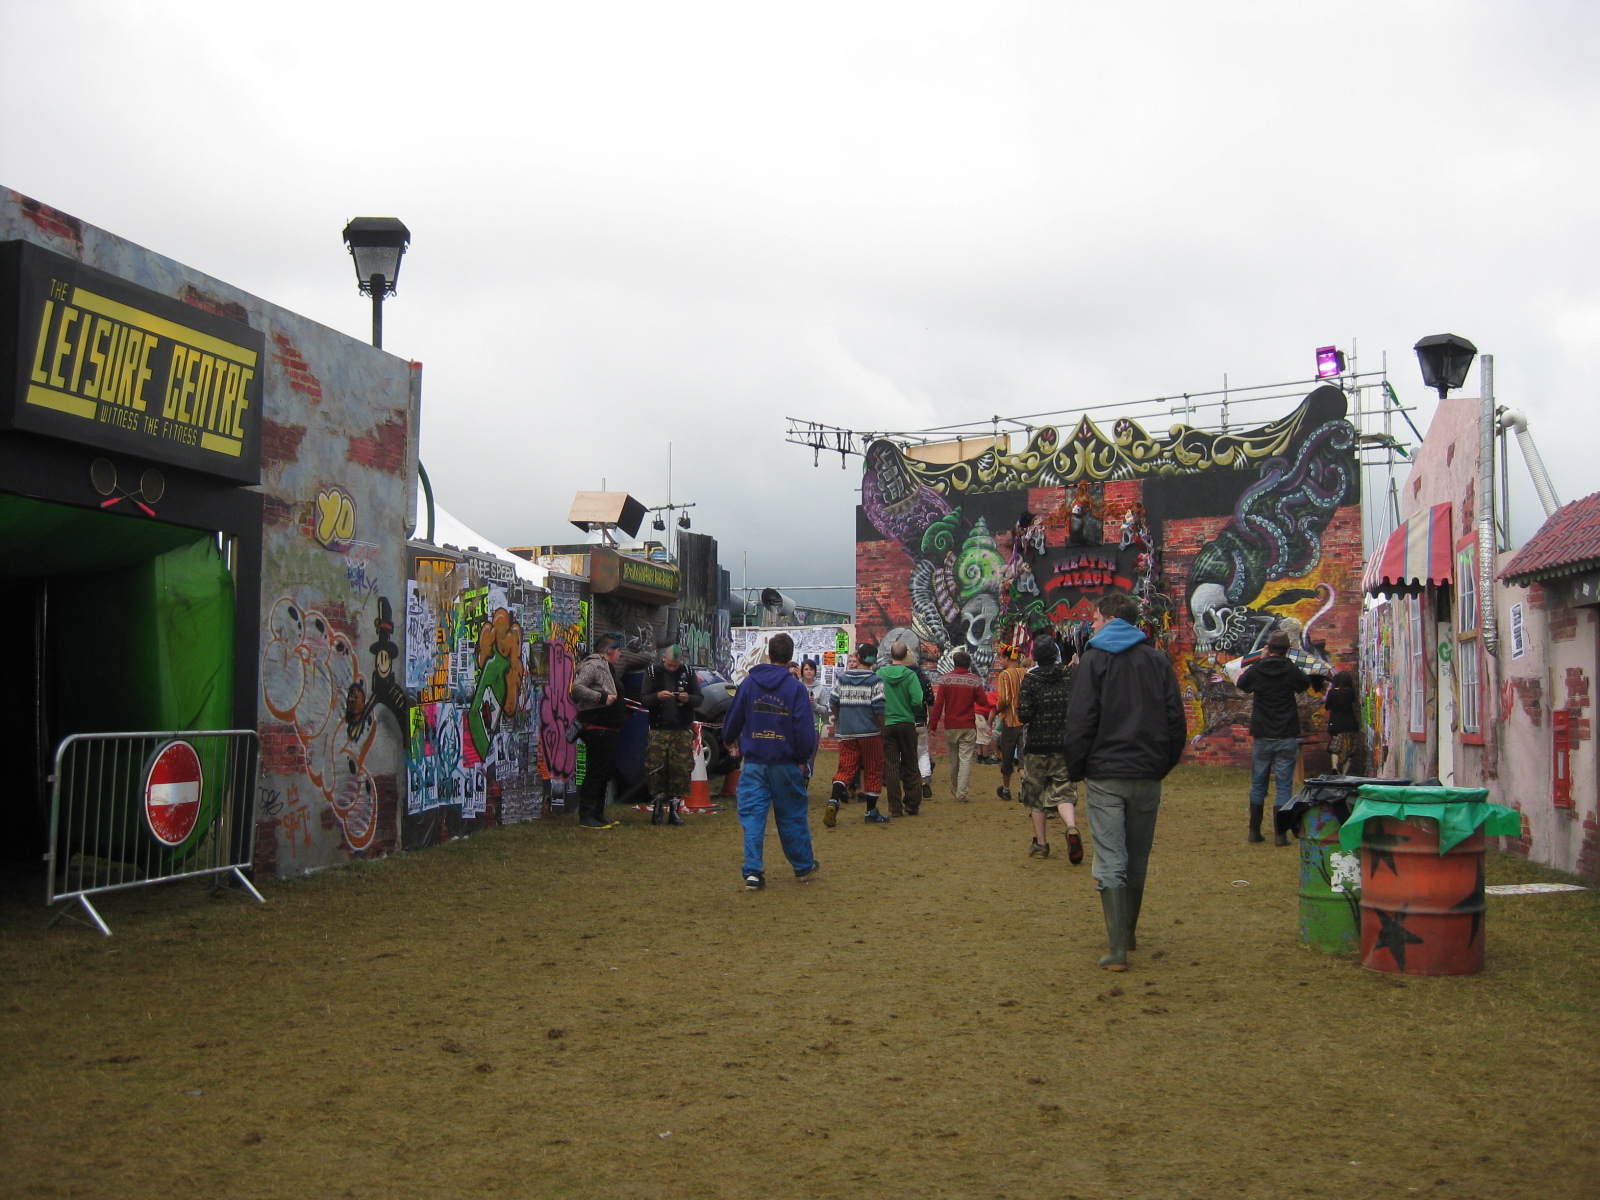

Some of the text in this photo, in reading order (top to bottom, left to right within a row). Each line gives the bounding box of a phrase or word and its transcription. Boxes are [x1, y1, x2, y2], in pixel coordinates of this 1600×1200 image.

[50, 278, 69, 301] THE
[31, 299, 255, 439] LEISURE CENTRE
[100, 404, 198, 446] WITNESS THE FITNESS
[467, 558, 490, 579] FREE
[1053, 553, 1117, 574] THEATRE
